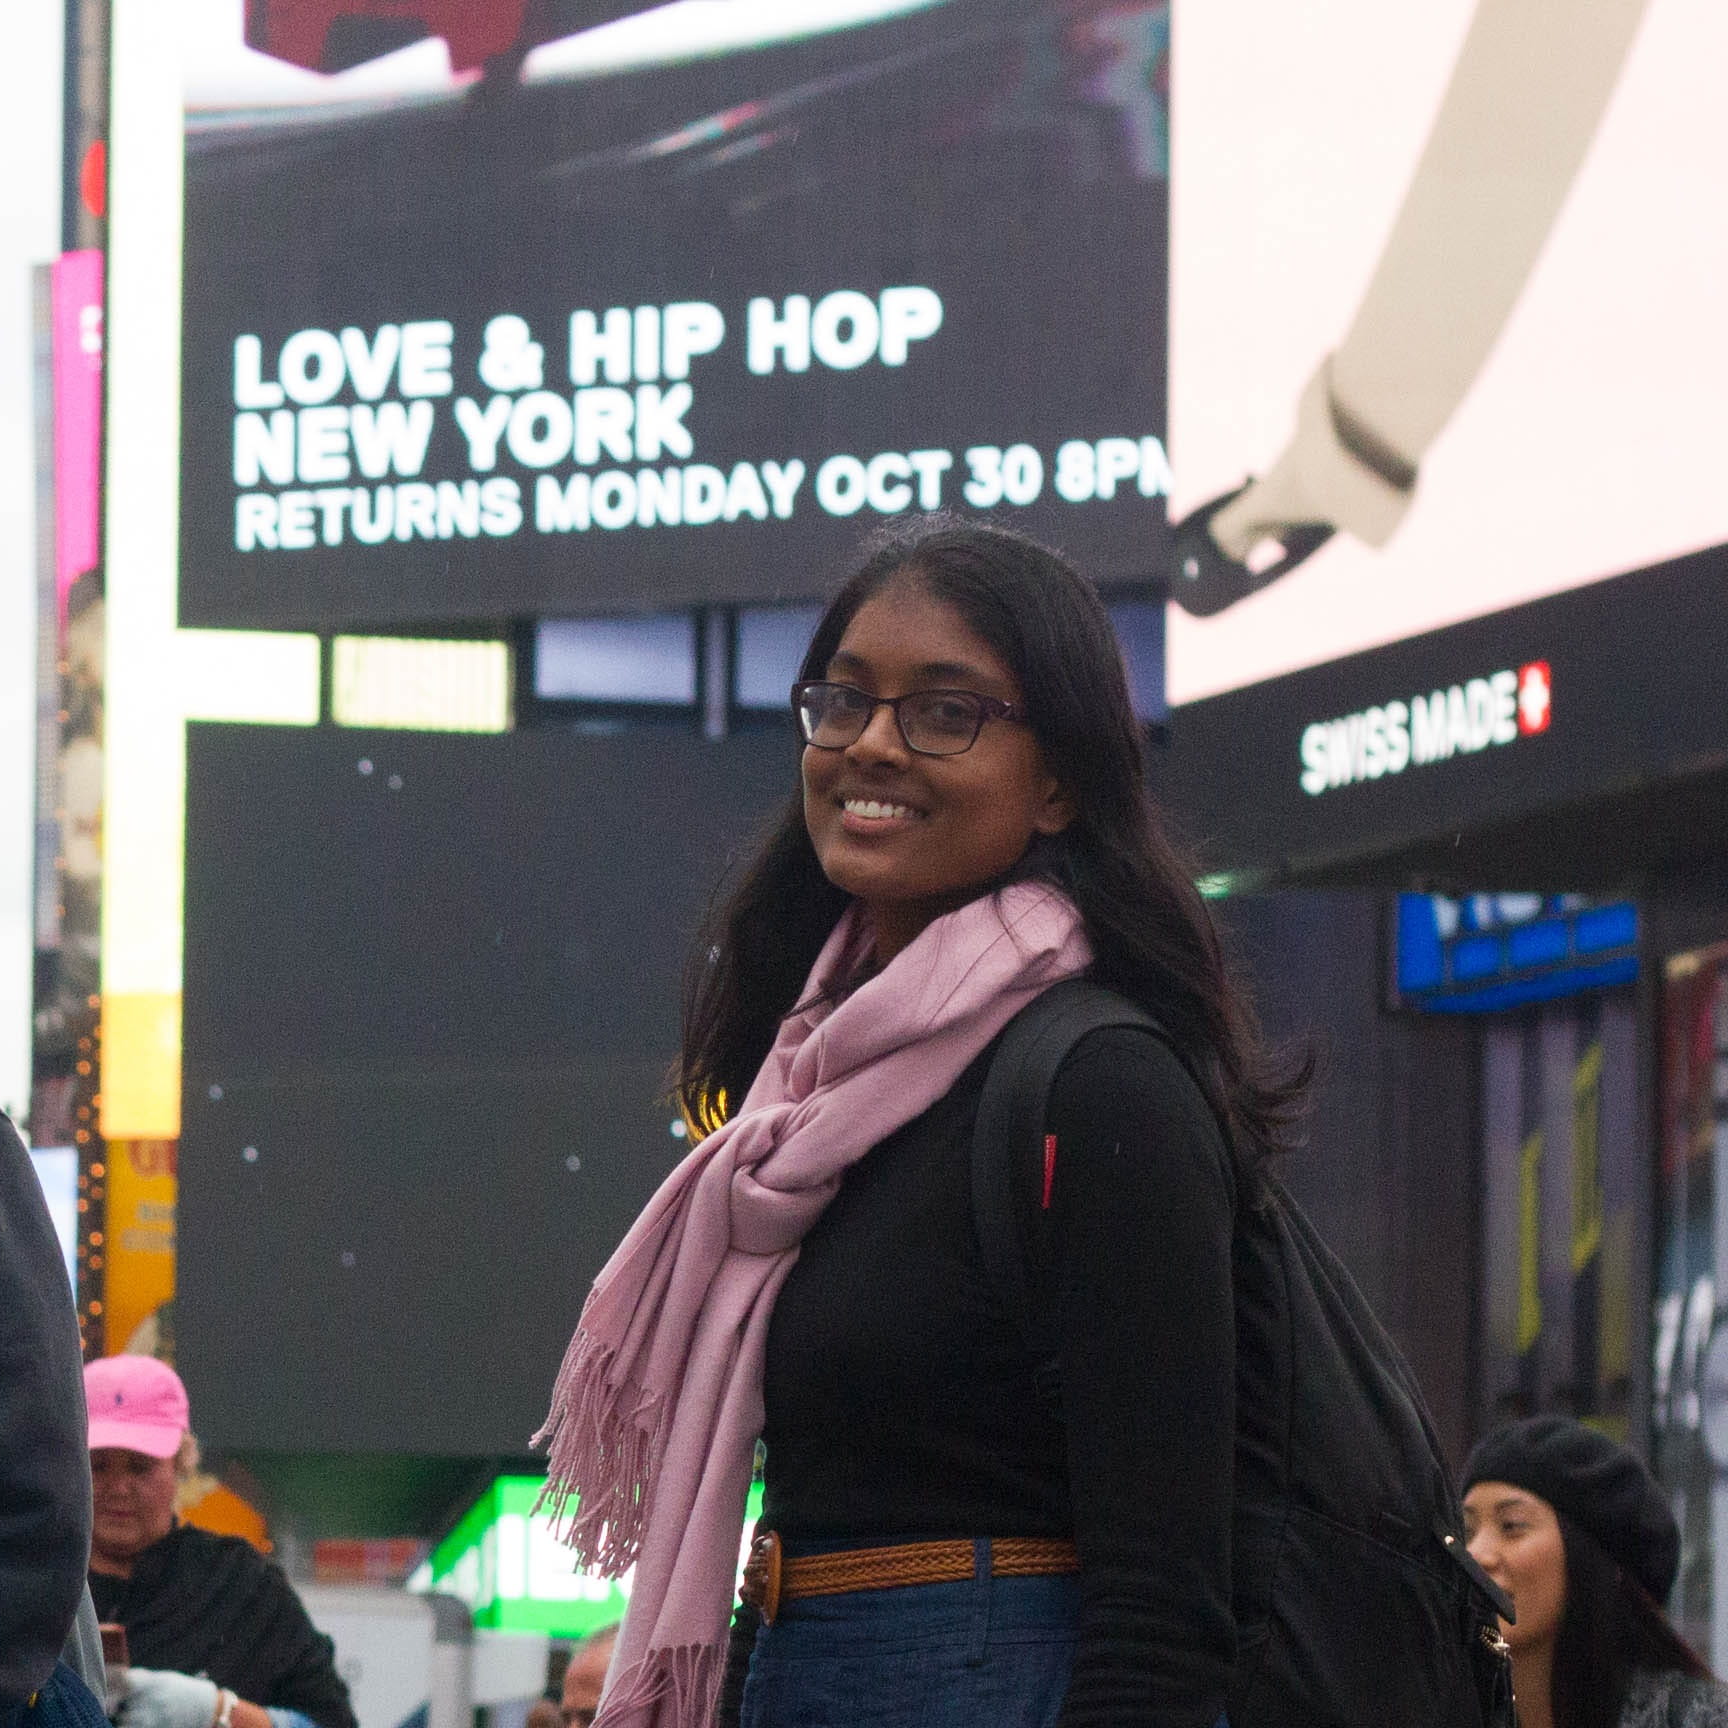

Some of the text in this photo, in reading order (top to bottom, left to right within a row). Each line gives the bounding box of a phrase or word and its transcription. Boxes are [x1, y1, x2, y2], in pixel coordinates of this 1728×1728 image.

[234, 286, 943, 410] LOVE & HIP HOP
[234, 381, 694, 487] NEW YORK
[236, 477, 524, 551] RETURNS
[535, 458, 806, 533] MONDAY
[816, 449, 953, 517] OCT
[963, 444, 1044, 508] 30
[1300, 670, 1518, 796] SWISS MADE
